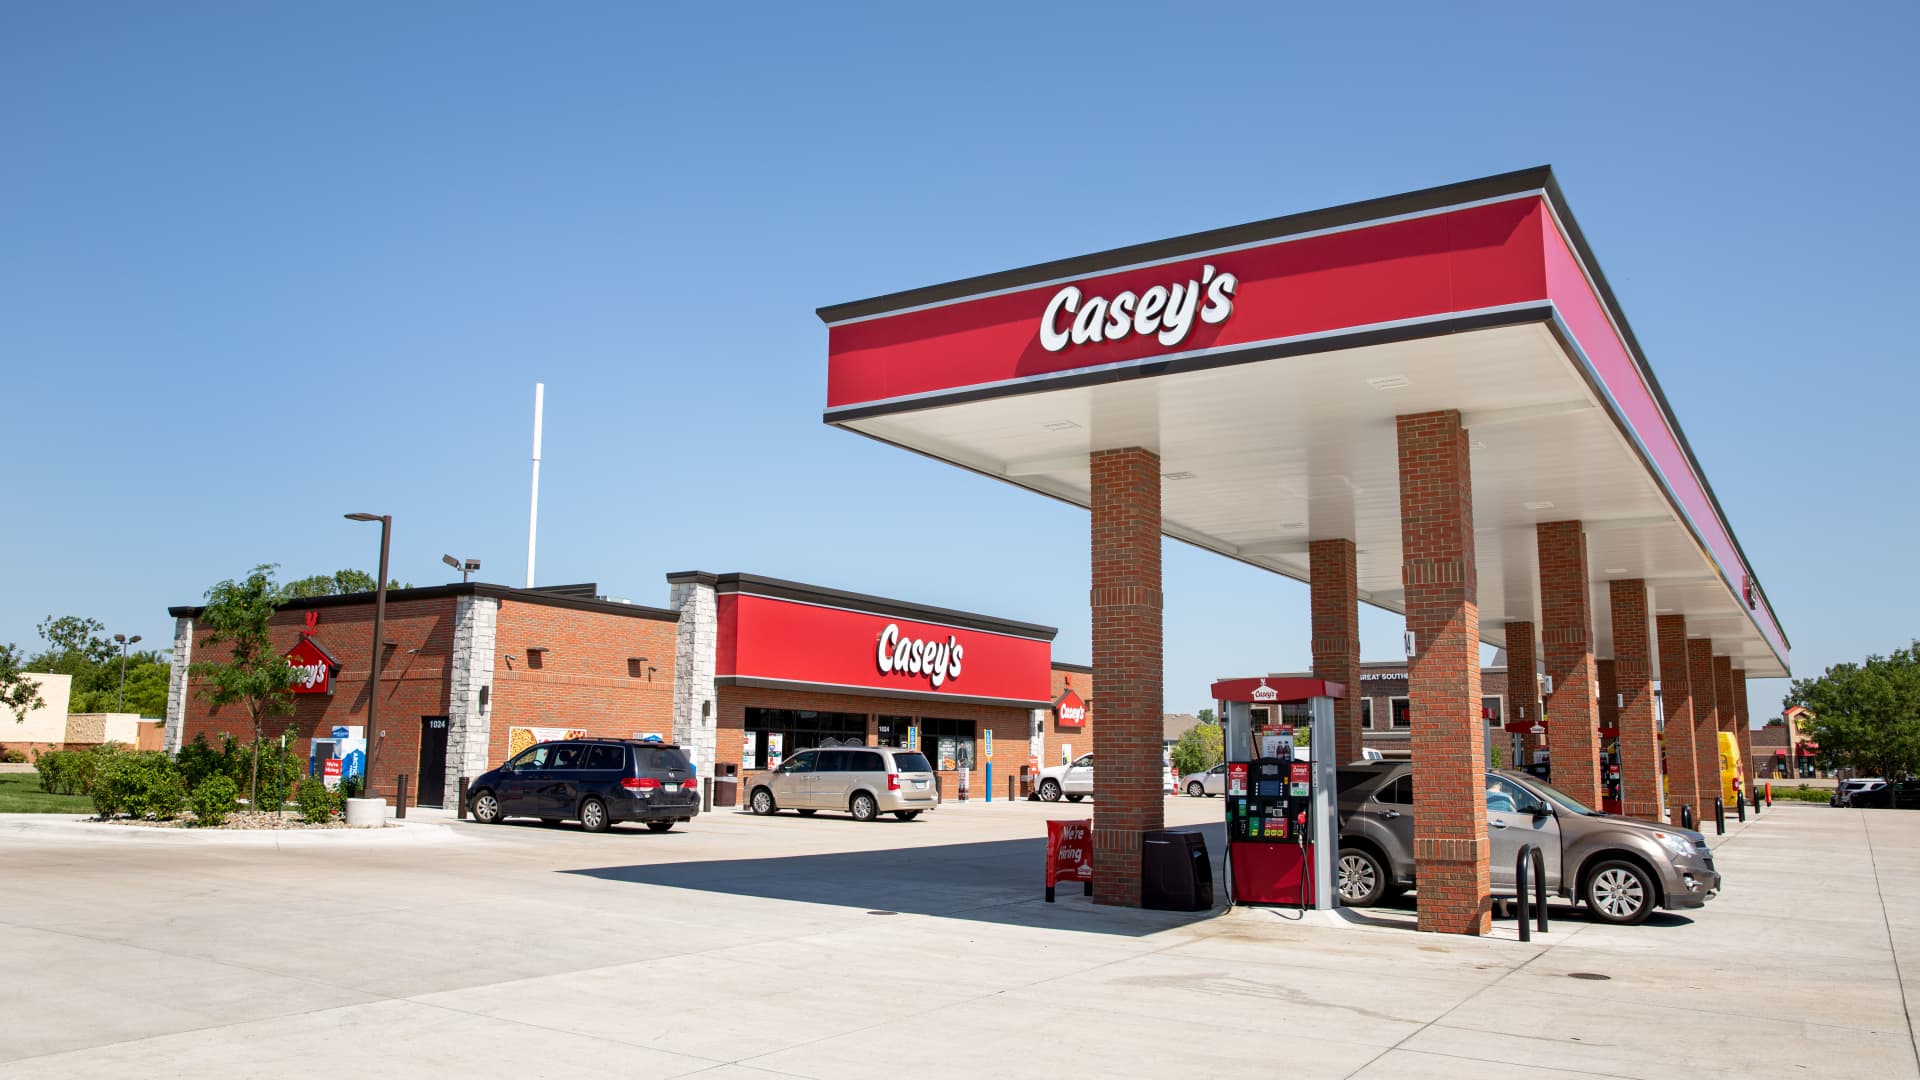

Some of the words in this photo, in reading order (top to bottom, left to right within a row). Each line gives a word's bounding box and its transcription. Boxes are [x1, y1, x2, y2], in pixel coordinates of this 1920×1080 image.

[1040, 265, 1237, 351] Casey's
[878, 624, 963, 687] Casey's
[1060, 703, 1085, 723] Casey's
[429, 720, 446, 728] 1024
[1063, 825, 1084, 840] We're
[1058, 845, 1082, 863] Hiring
